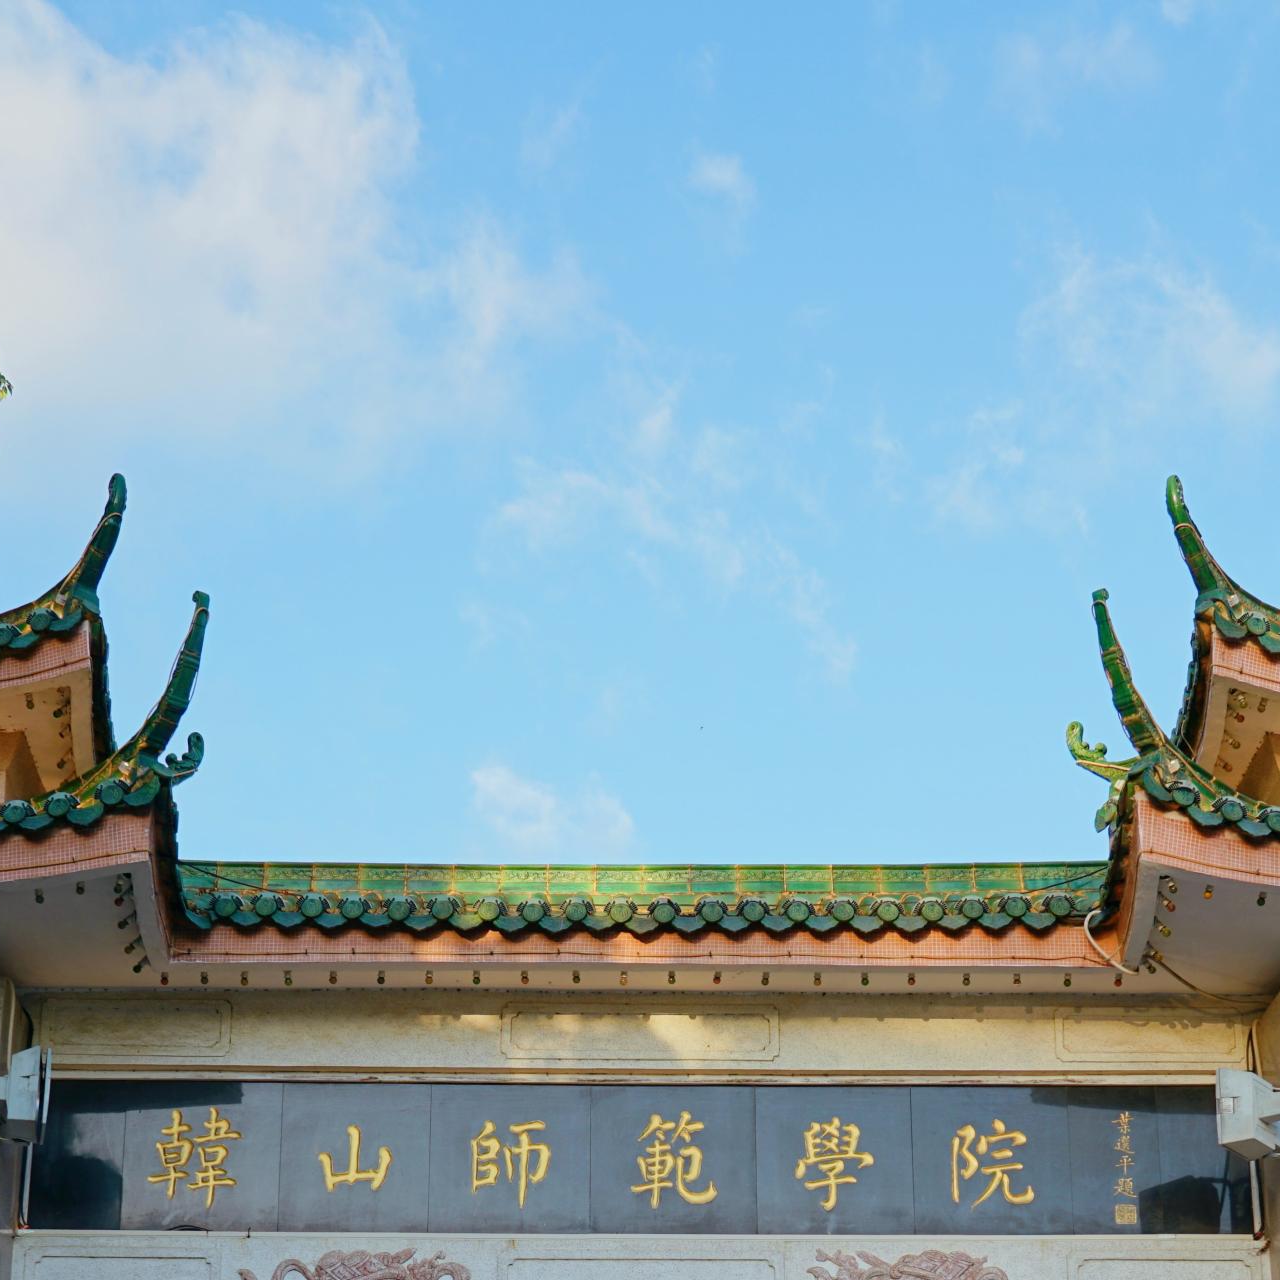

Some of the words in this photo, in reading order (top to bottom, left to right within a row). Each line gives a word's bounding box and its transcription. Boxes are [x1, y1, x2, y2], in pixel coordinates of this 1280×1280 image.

[147, 1106, 1035, 1210] 韓山師範學院
